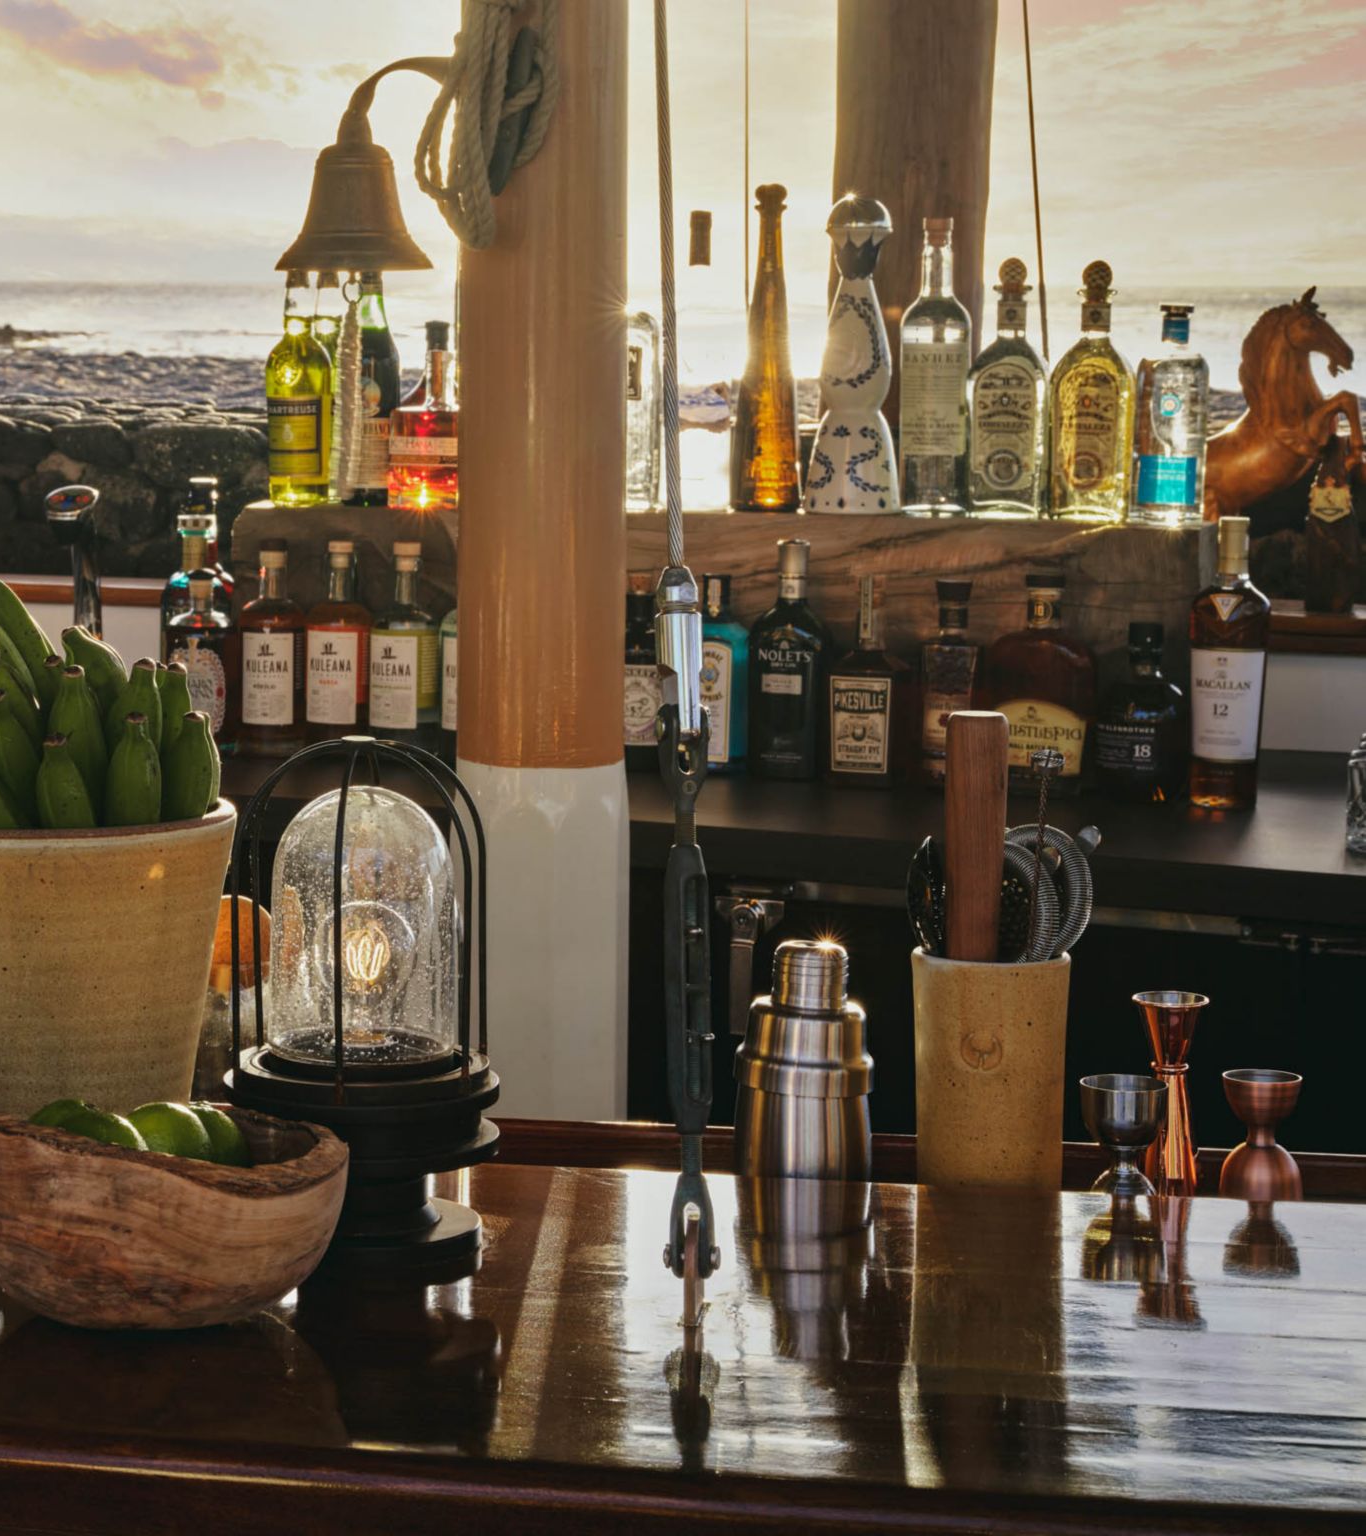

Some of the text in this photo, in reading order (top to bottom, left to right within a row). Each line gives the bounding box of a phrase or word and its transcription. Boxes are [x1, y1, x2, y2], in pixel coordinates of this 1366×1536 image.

[269, 404, 317, 414] HARTREUSE
[246, 660, 288, 672] KULEANA
[310, 658, 352, 672] KULEANA
[372, 662, 411, 676] KULEANA
[1195, 679, 1251, 690] MACALLAN
[834, 690, 885, 710] PIKESVILLE
[1213, 703, 1229, 717] 12
[1009, 724, 1082, 741] ISTLEPIG
[1134, 744, 1152, 758] 18
